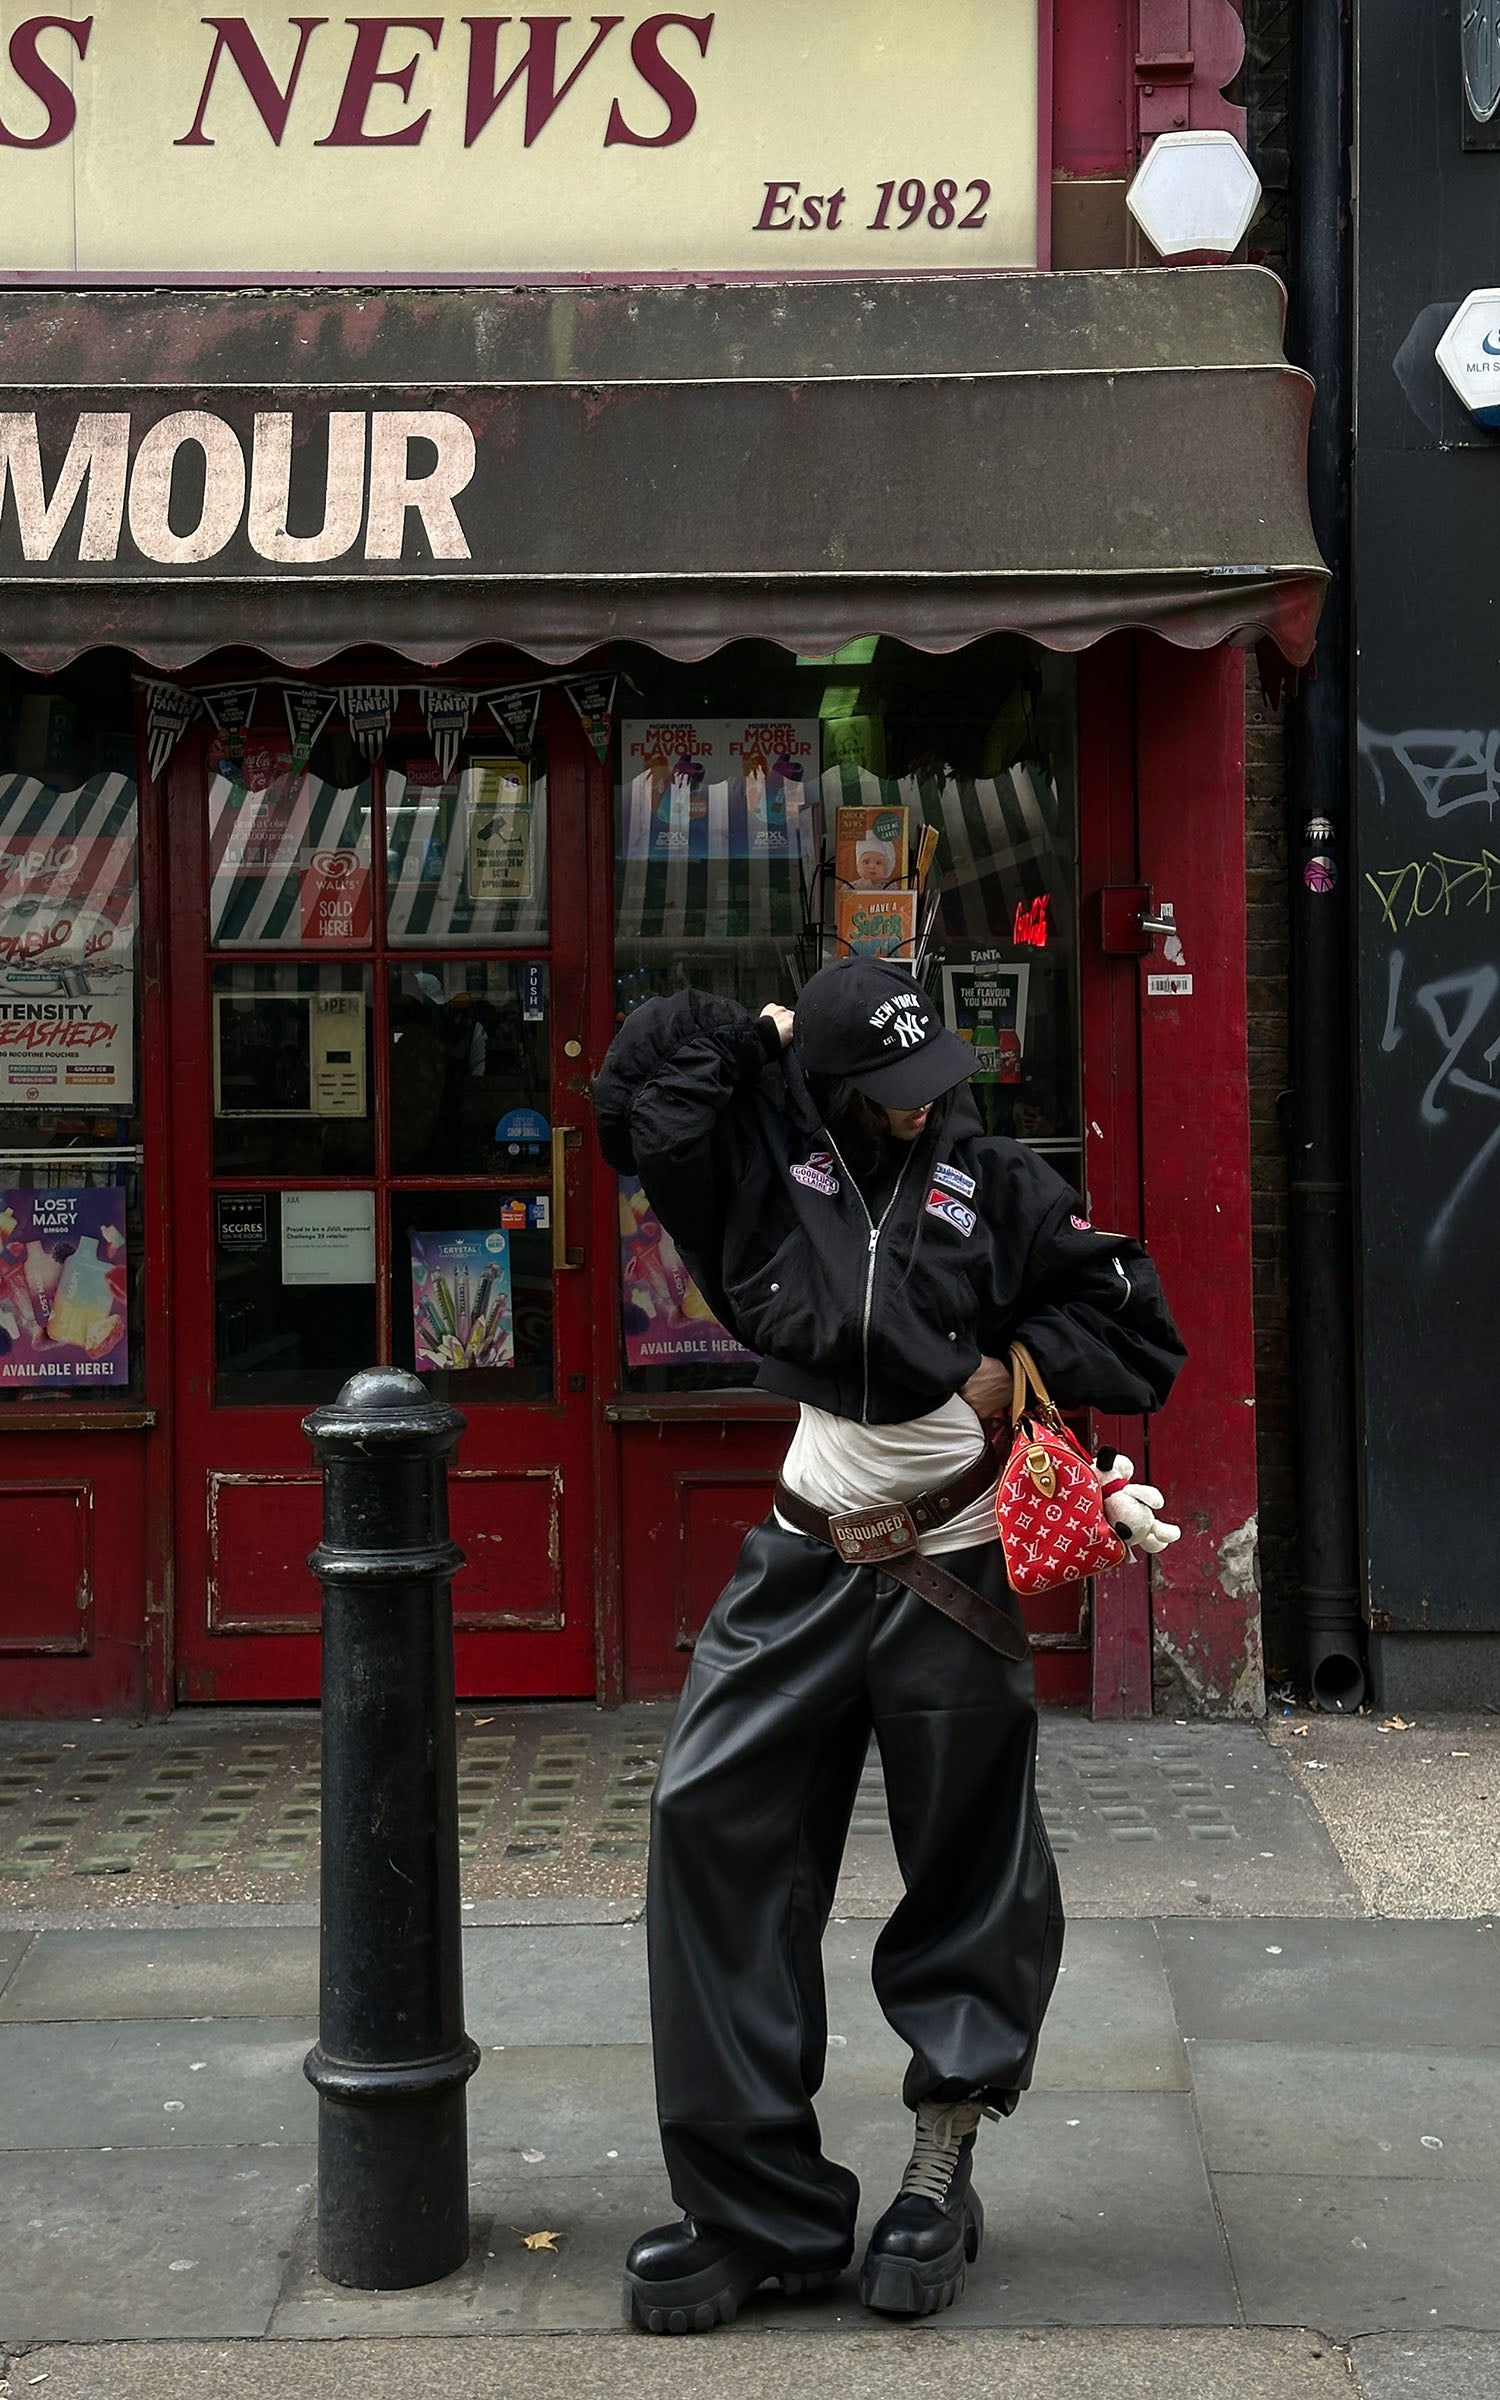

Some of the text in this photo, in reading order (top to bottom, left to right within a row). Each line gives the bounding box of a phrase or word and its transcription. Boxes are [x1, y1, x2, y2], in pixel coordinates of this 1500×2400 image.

[173, 13, 715, 149] NEWS
[752, 178, 991, 230] Est 1982
[1466, 362, 1490, 372] MLR
[0, 409, 477, 565] MOUR
[153, 694, 194, 715] FANTA
[350, 696, 389, 713] FANTA
[429, 696, 470, 712] FANTA
[645, 730, 697, 743] MORE
[744, 729, 796, 742] MORE
[630, 743, 713, 756] FLAVOUR
[729, 742, 812, 755] FLAVOUR
[316, 881, 356, 890] WALL'S
[319, 900, 353, 917] SOLD
[869, 903, 890, 915] HAVE
[319, 919, 354, 937] HERE!
[970, 948, 1002, 961] FANTA
[530, 967, 538, 1006] PUSH
[960, 987, 1011, 997] THE FLAVOUR
[963, 997, 1007, 1007] YOU WANTA
[0, 1004, 93, 1020] TENSITY
[869, 993, 920, 1029] NEW YORK
[883, 1035, 897, 1046] EST.
[34, 1199, 77, 1211] LOST
[33, 1213, 78, 1225] MARY
[222, 1223, 263, 1234] SCORES
[443, 1246, 477, 1254] CRYSTAL
[640, 1340, 708, 1356] AVAILABLE
[2, 1361, 115, 1377] AVAILABLE HERE!
